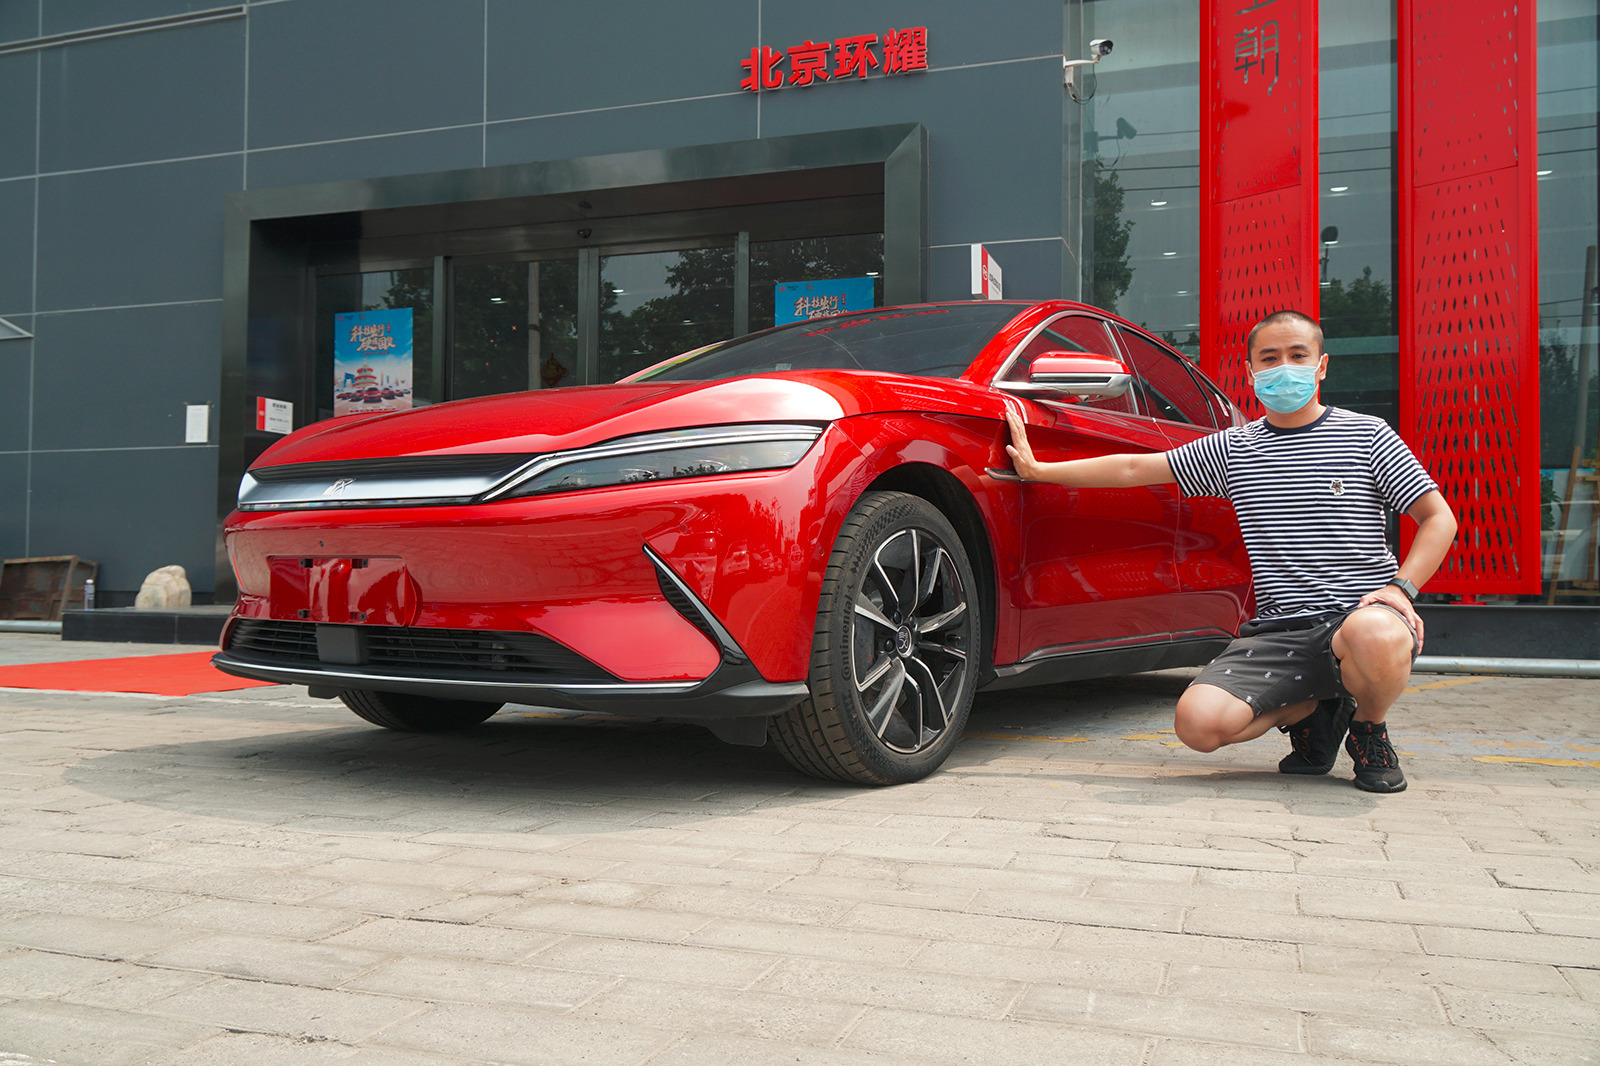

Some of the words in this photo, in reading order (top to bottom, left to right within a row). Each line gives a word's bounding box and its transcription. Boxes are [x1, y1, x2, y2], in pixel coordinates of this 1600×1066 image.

[740, 26, 928, 93] 北京环耀
[840, 594, 853, 681] Continental
